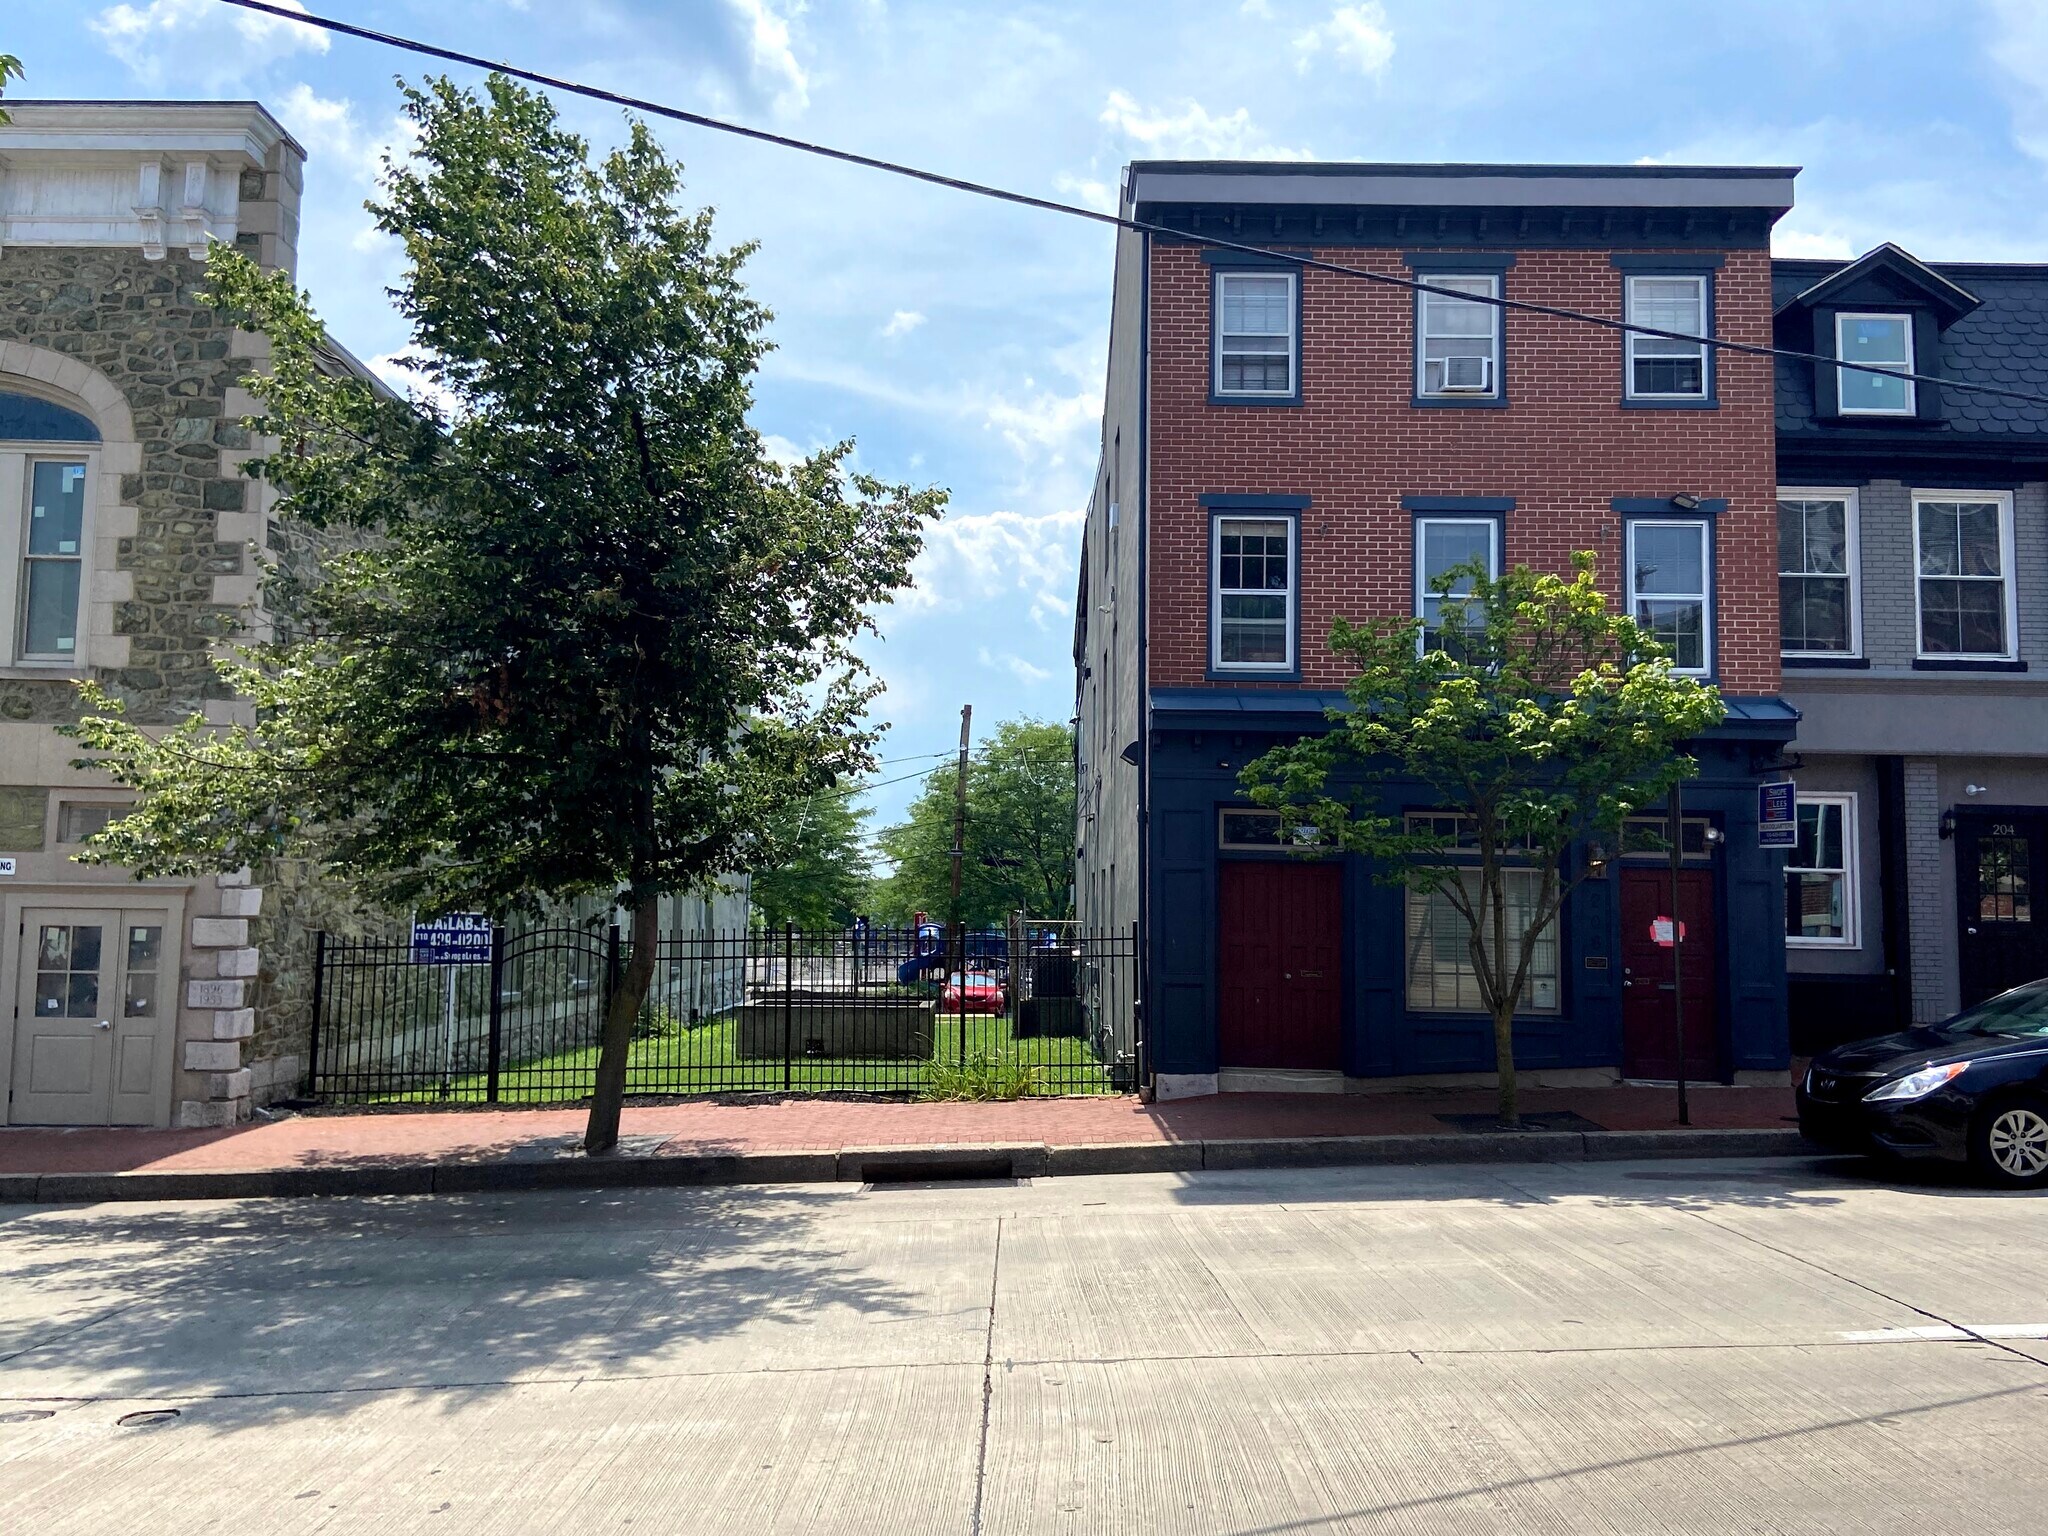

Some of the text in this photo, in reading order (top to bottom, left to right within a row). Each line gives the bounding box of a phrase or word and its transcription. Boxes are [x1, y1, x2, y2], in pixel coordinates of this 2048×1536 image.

[1773, 800, 1787, 808] LEES
[1992, 824, 2015, 835] 204
[416, 917, 489, 931] AVAILABLE
[200, 984, 223, 994] 1896
